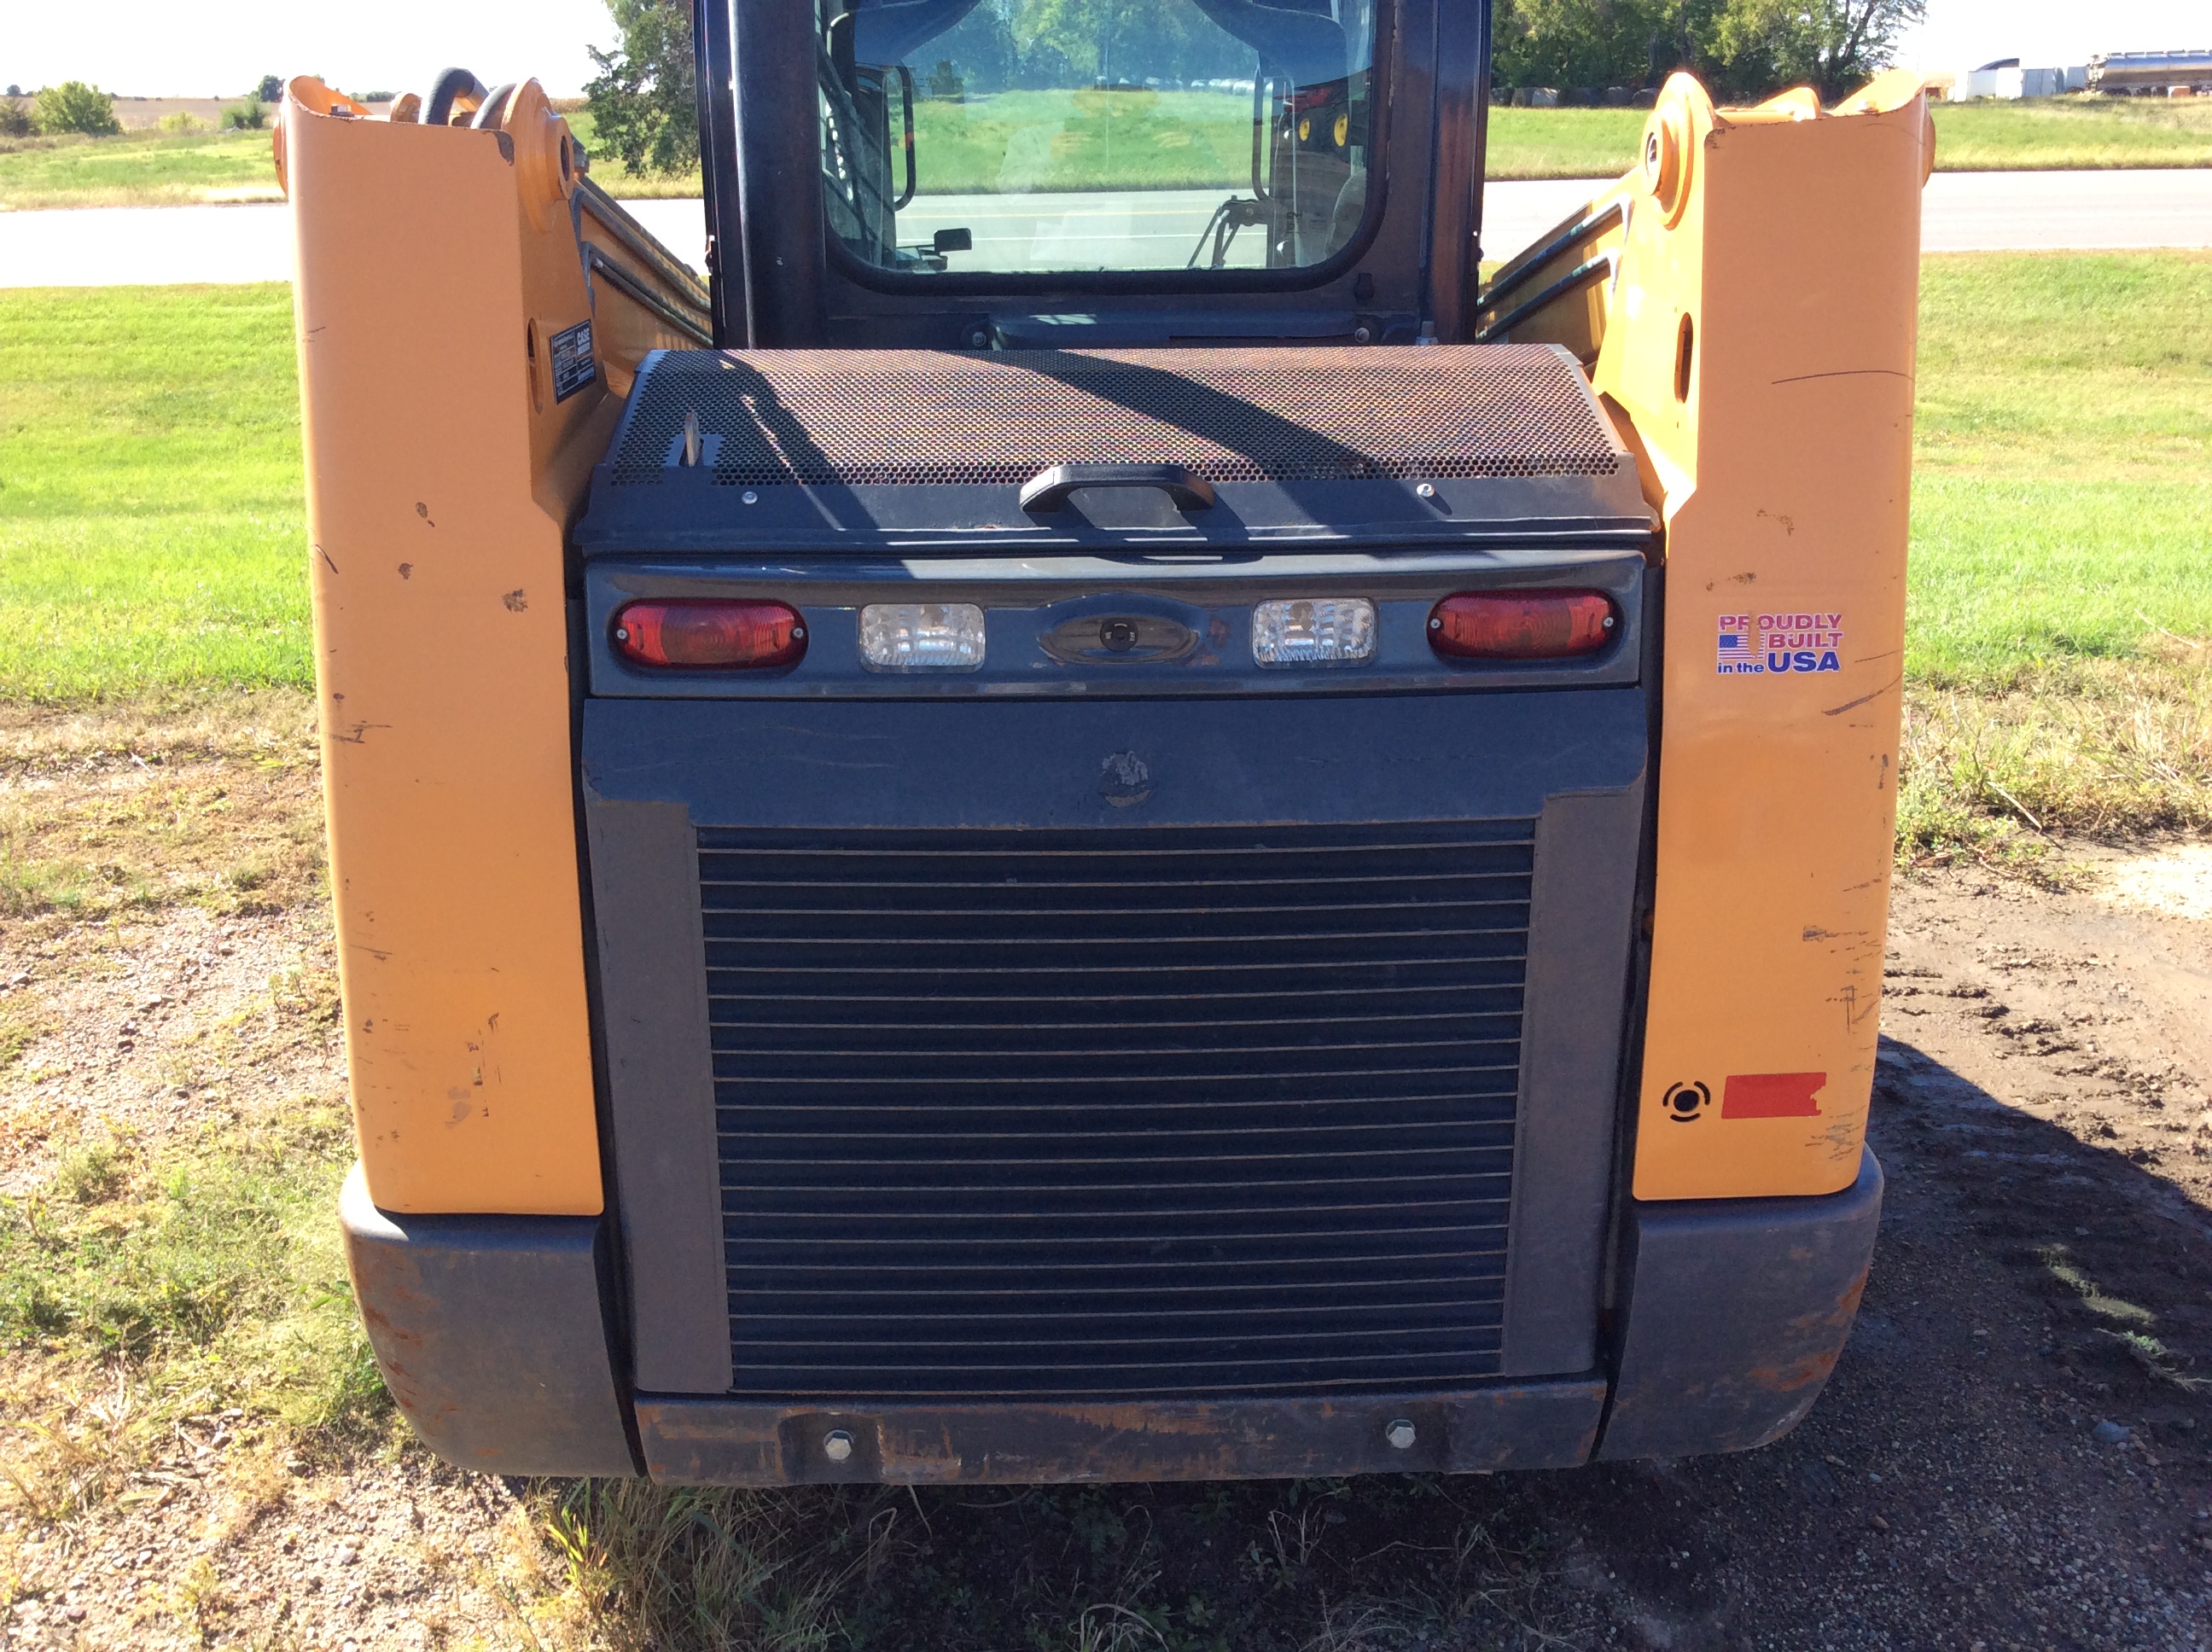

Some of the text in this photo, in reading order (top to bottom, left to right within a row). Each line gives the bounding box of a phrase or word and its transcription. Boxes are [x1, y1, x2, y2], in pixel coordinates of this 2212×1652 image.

[577, 328, 591, 346] CASE
[1768, 632, 1843, 649] BUILT
[1718, 651, 1841, 673] in the USA
